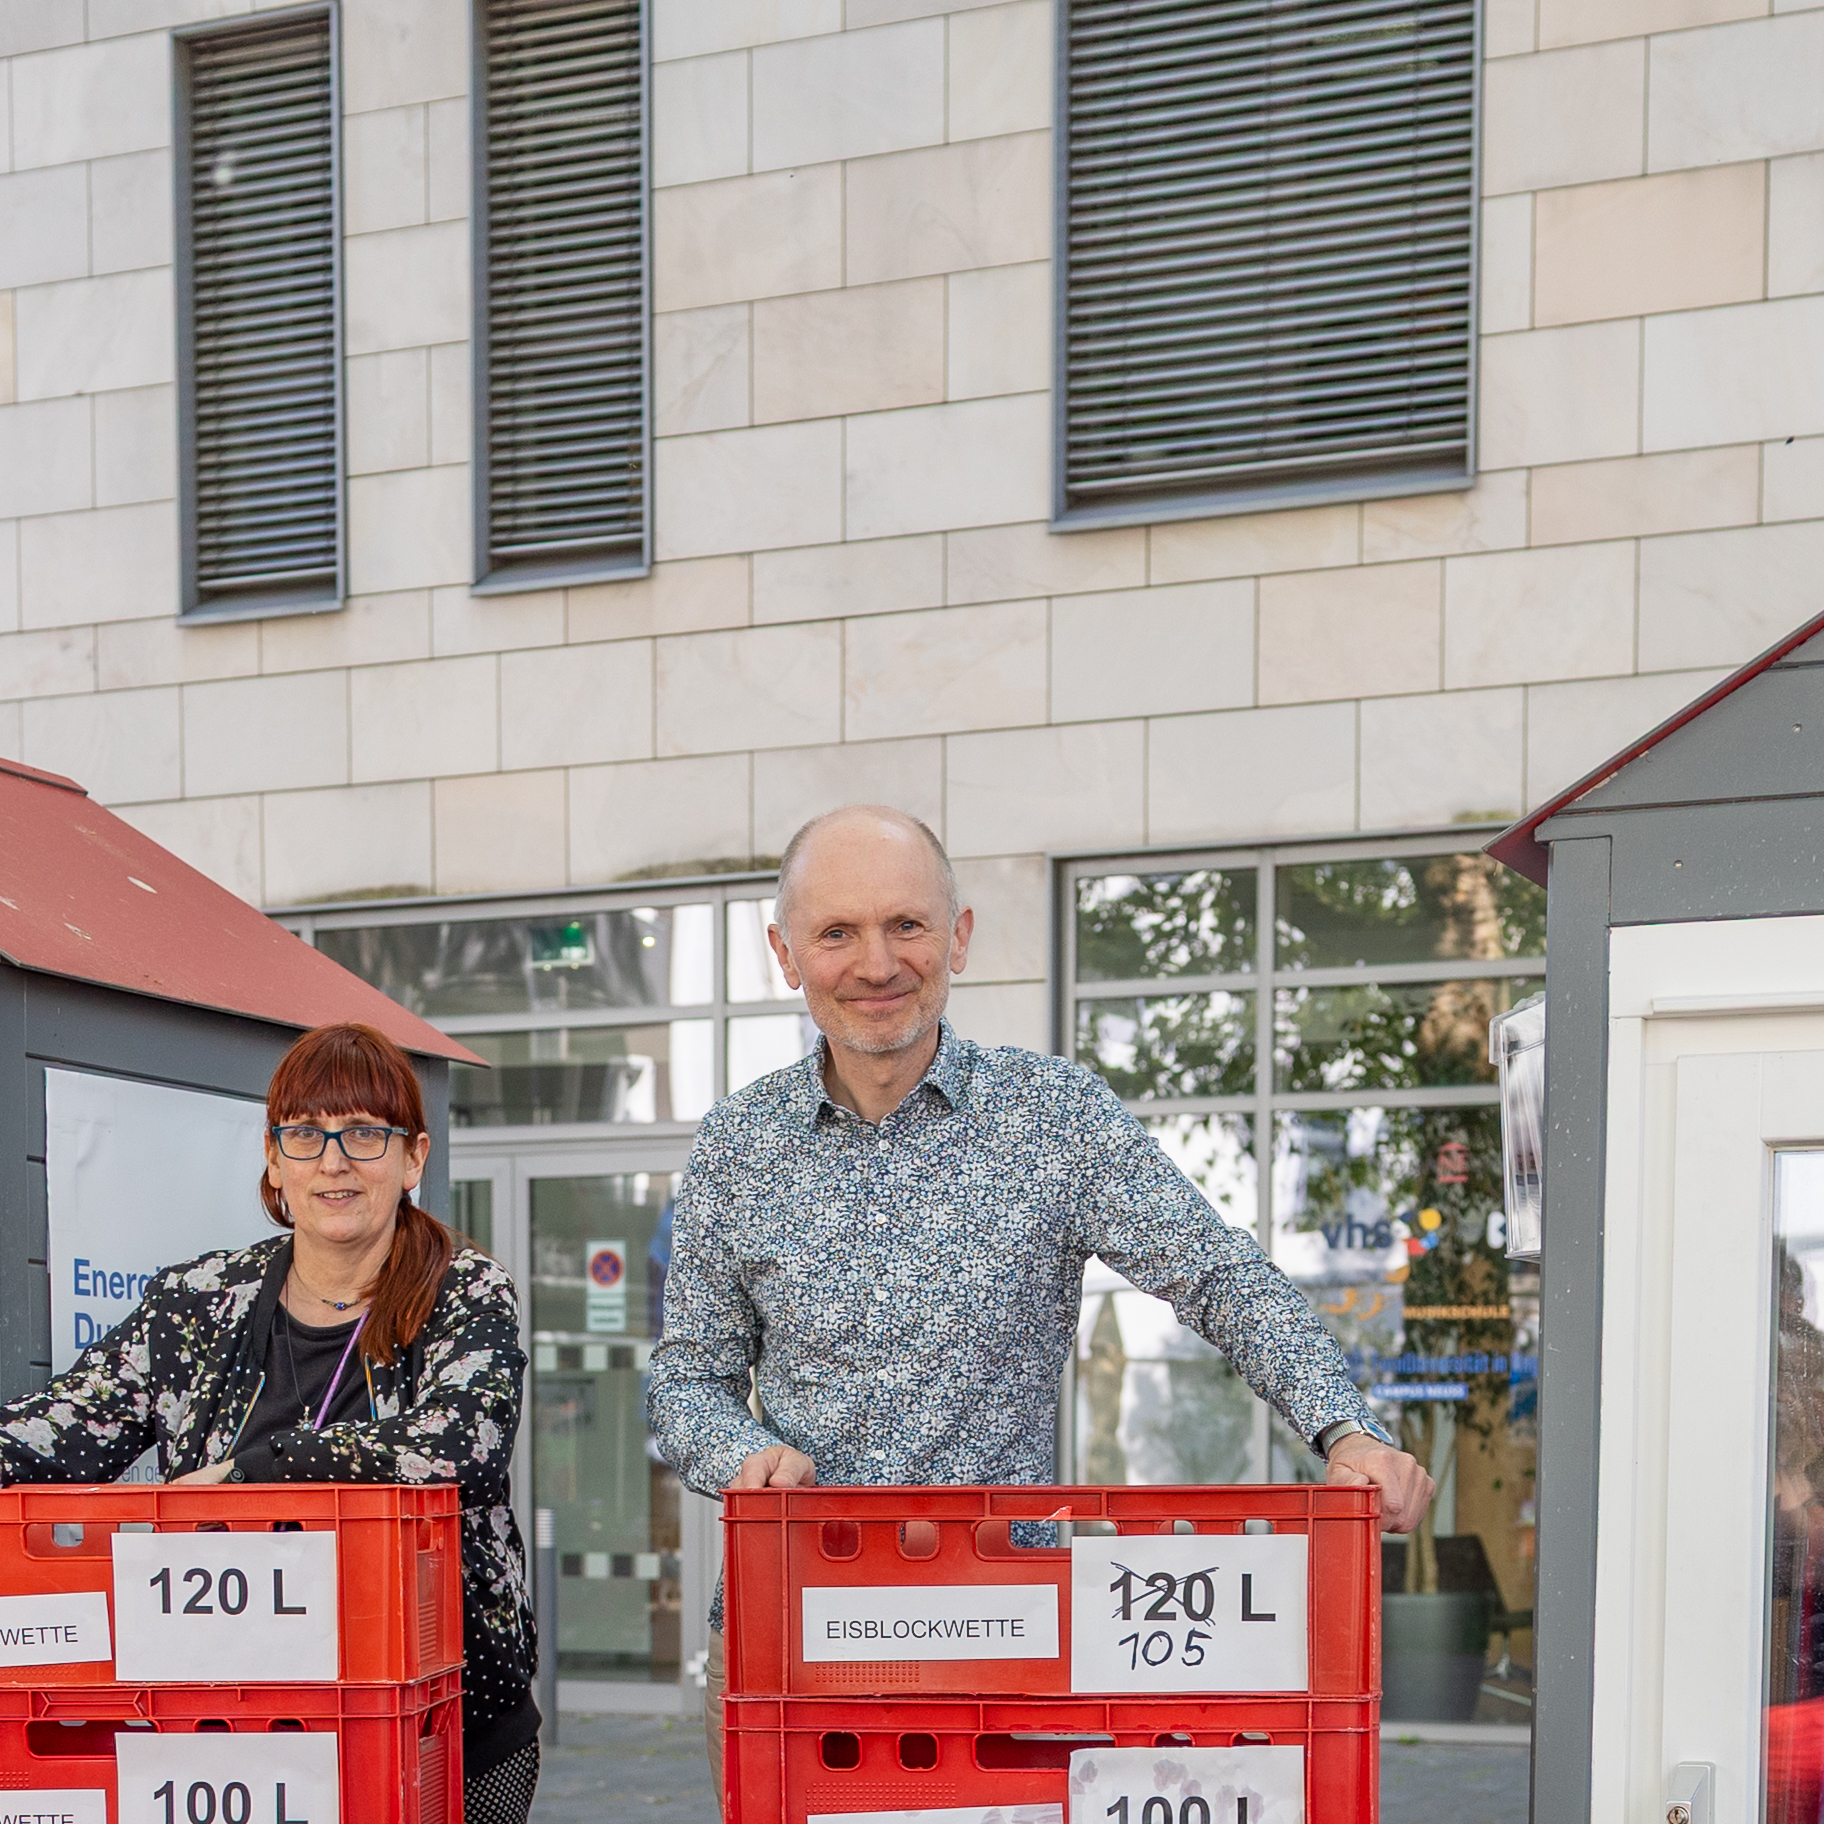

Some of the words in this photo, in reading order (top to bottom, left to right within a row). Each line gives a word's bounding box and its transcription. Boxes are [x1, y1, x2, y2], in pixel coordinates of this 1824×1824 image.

[1320, 1213, 1393, 1249] vhs
[150, 1568, 247, 1615] 120
[274, 1569, 306, 1614] L
[1110, 1572, 1216, 1623] 120
[1242, 1574, 1275, 1621] L
[828, 1619, 1024, 1638] EISBLOCKWETTE
[1119, 1629, 1212, 1670] 105
